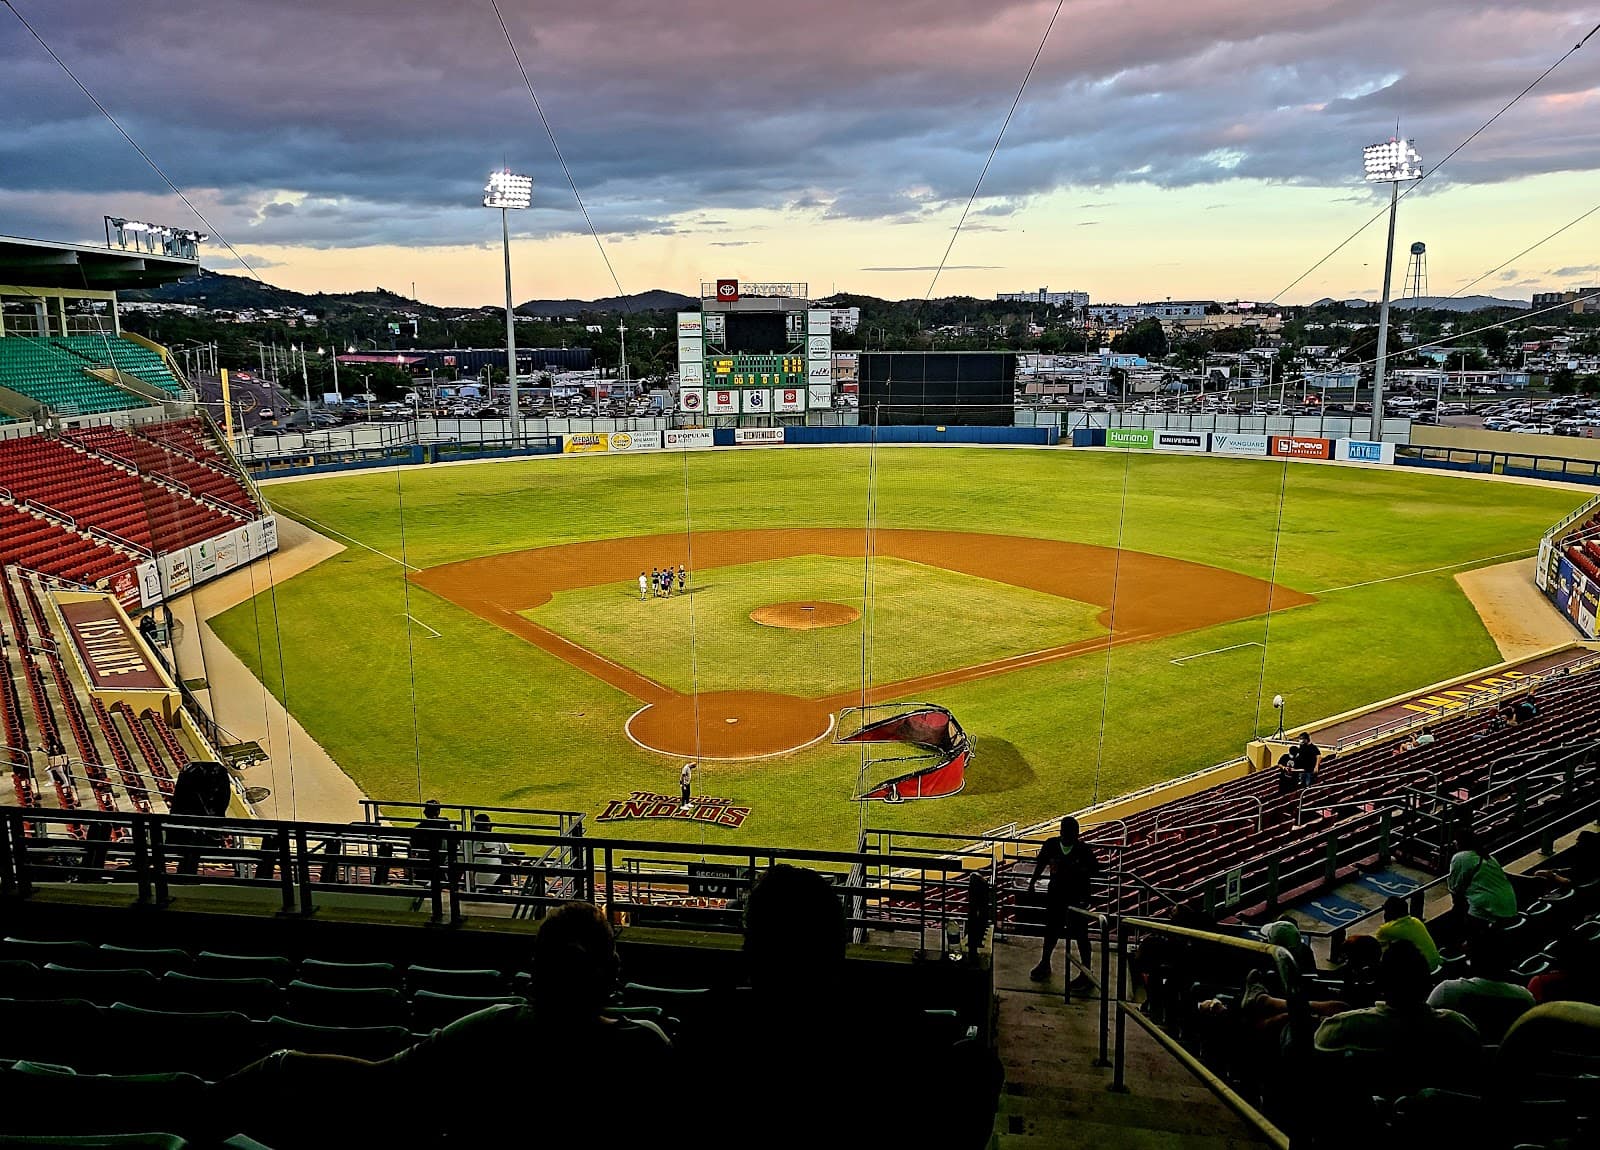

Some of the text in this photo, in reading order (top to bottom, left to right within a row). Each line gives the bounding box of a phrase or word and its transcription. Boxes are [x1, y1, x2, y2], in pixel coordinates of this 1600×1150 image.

[743, 284, 793, 297] TOYOTA
[1111, 432, 1149, 442] Humana
[1161, 437, 1199, 445] UNIVERSAL
[1292, 440, 1323, 449] brava
[595, 801, 752, 828] INDIOS
